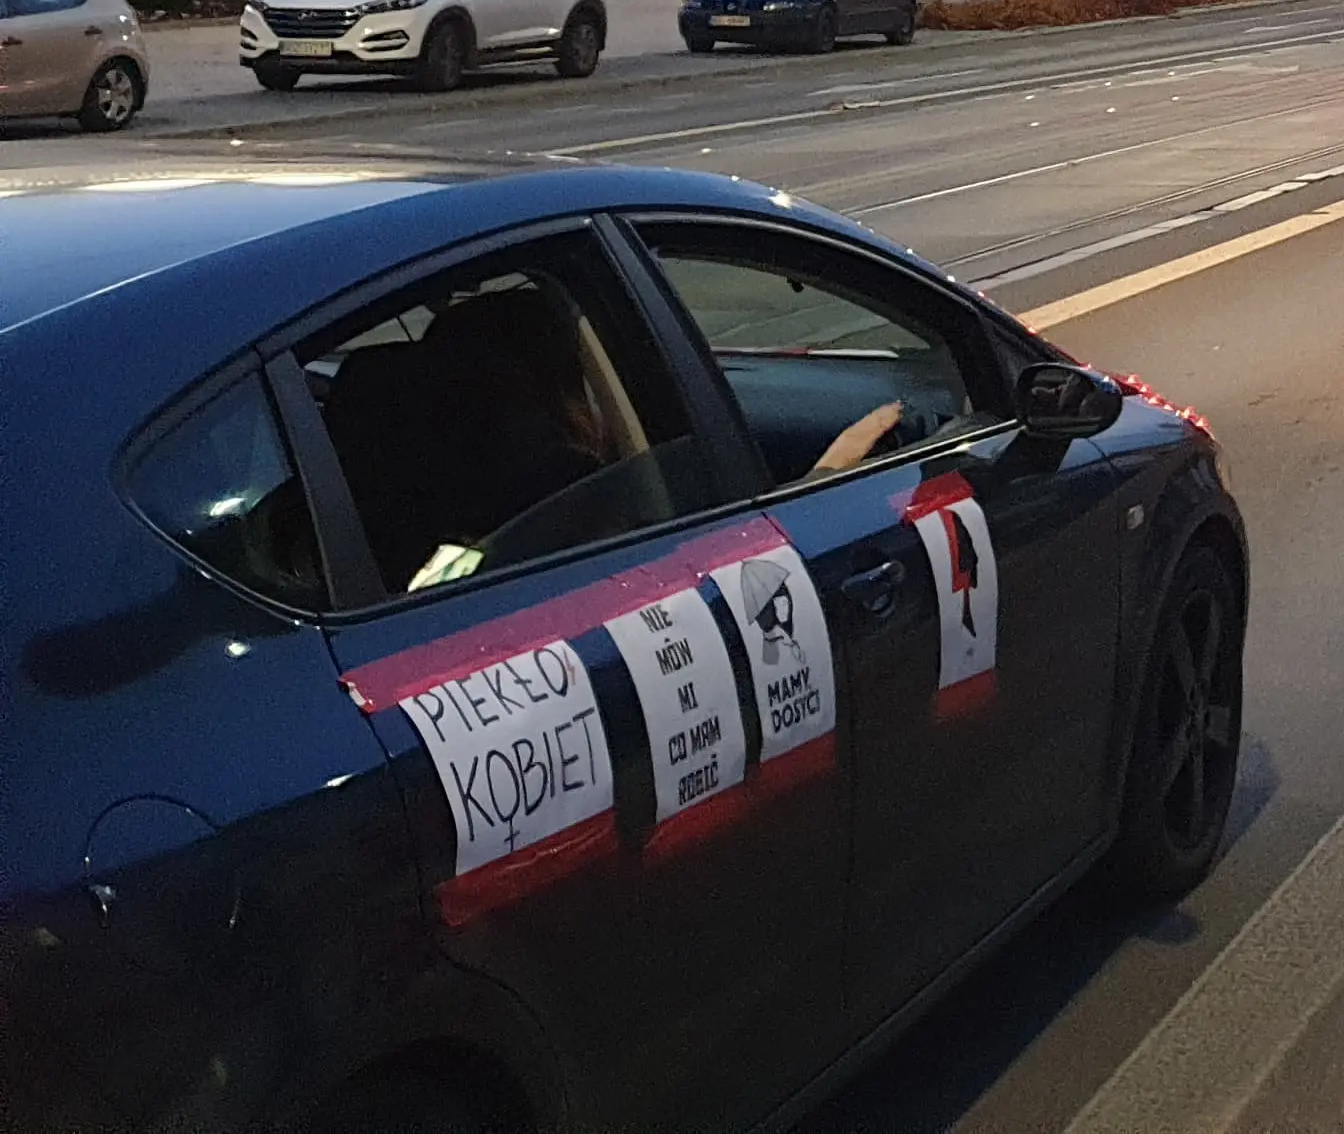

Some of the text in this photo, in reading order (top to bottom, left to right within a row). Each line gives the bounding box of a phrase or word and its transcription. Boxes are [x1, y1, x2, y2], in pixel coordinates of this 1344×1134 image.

[639, 604, 674, 633] NIE
[412, 647, 569, 742] PIEKŁO
[677, 681, 699, 714] MI
[767, 666, 811, 707] MAMY
[668, 715, 722, 765] CO MAM
[450, 707, 596, 843] KOBIET
